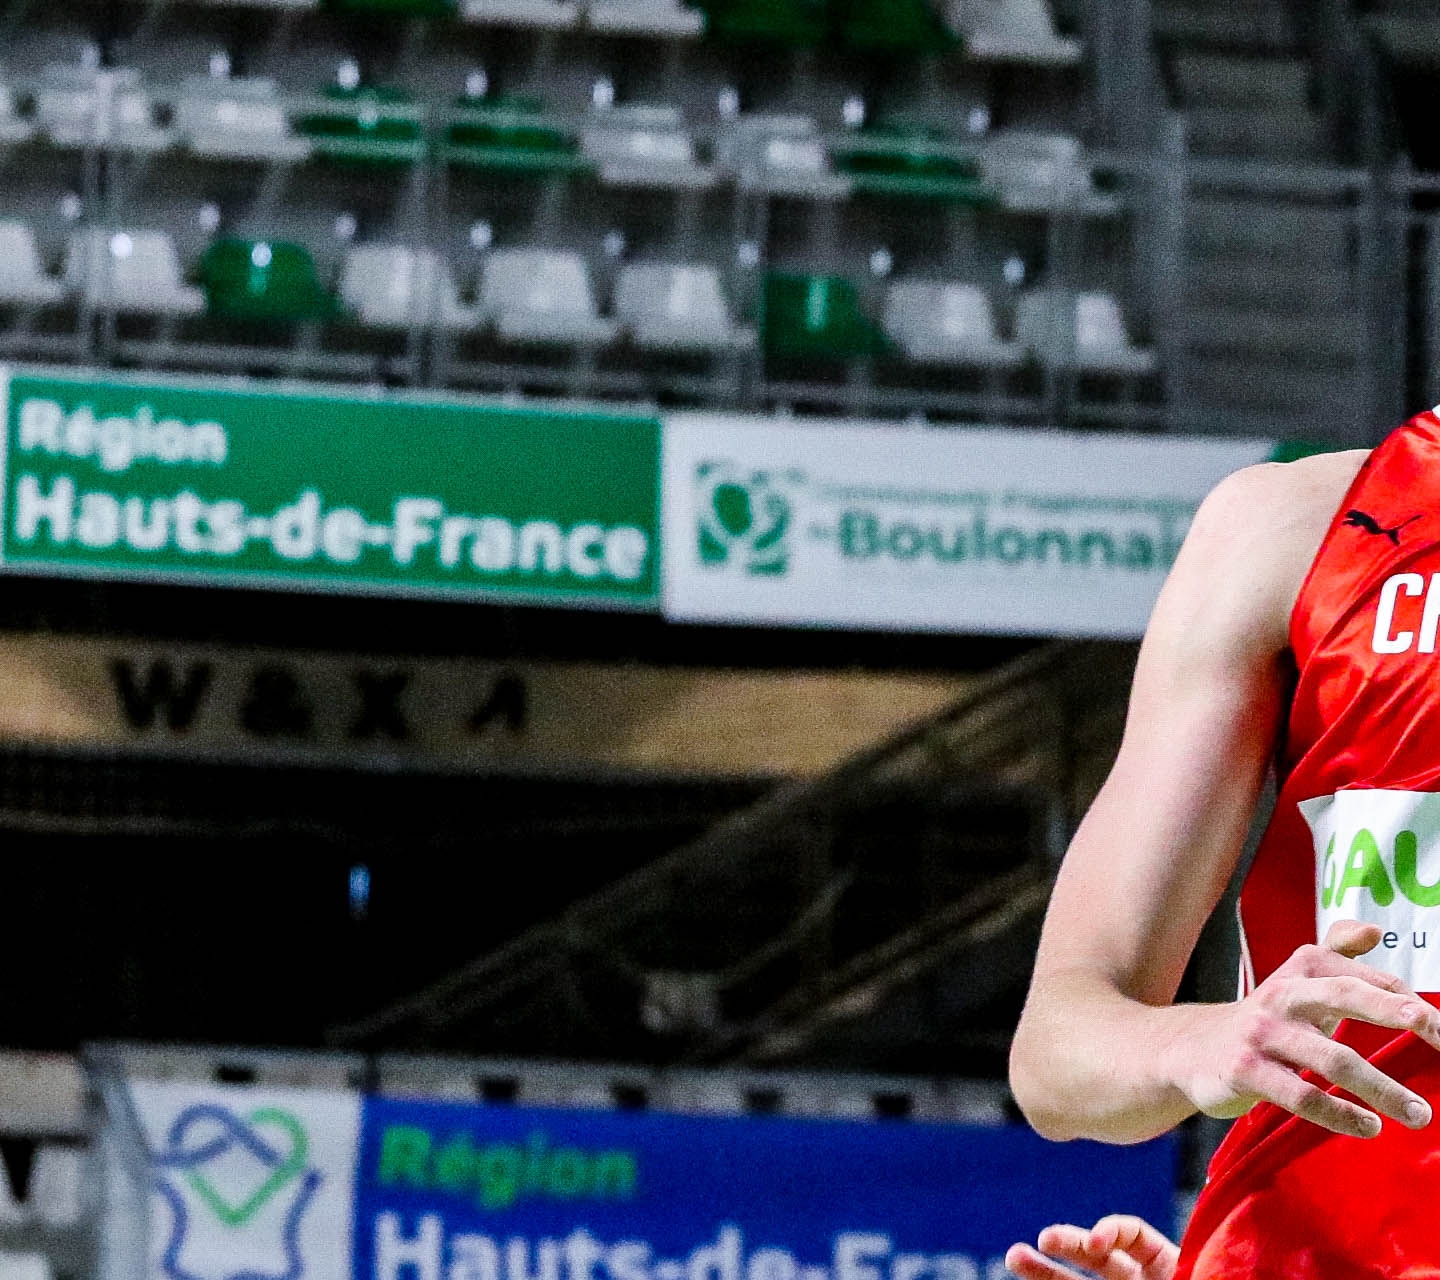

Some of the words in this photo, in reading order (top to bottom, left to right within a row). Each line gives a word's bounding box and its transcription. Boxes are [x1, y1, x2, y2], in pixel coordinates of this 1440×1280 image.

[16, 393, 230, 473] Région
[13, 473, 649, 582] Hauts-de-France
[839, 509, 1184, 570] Boulonnai
[378, 1122, 639, 1209] Région
